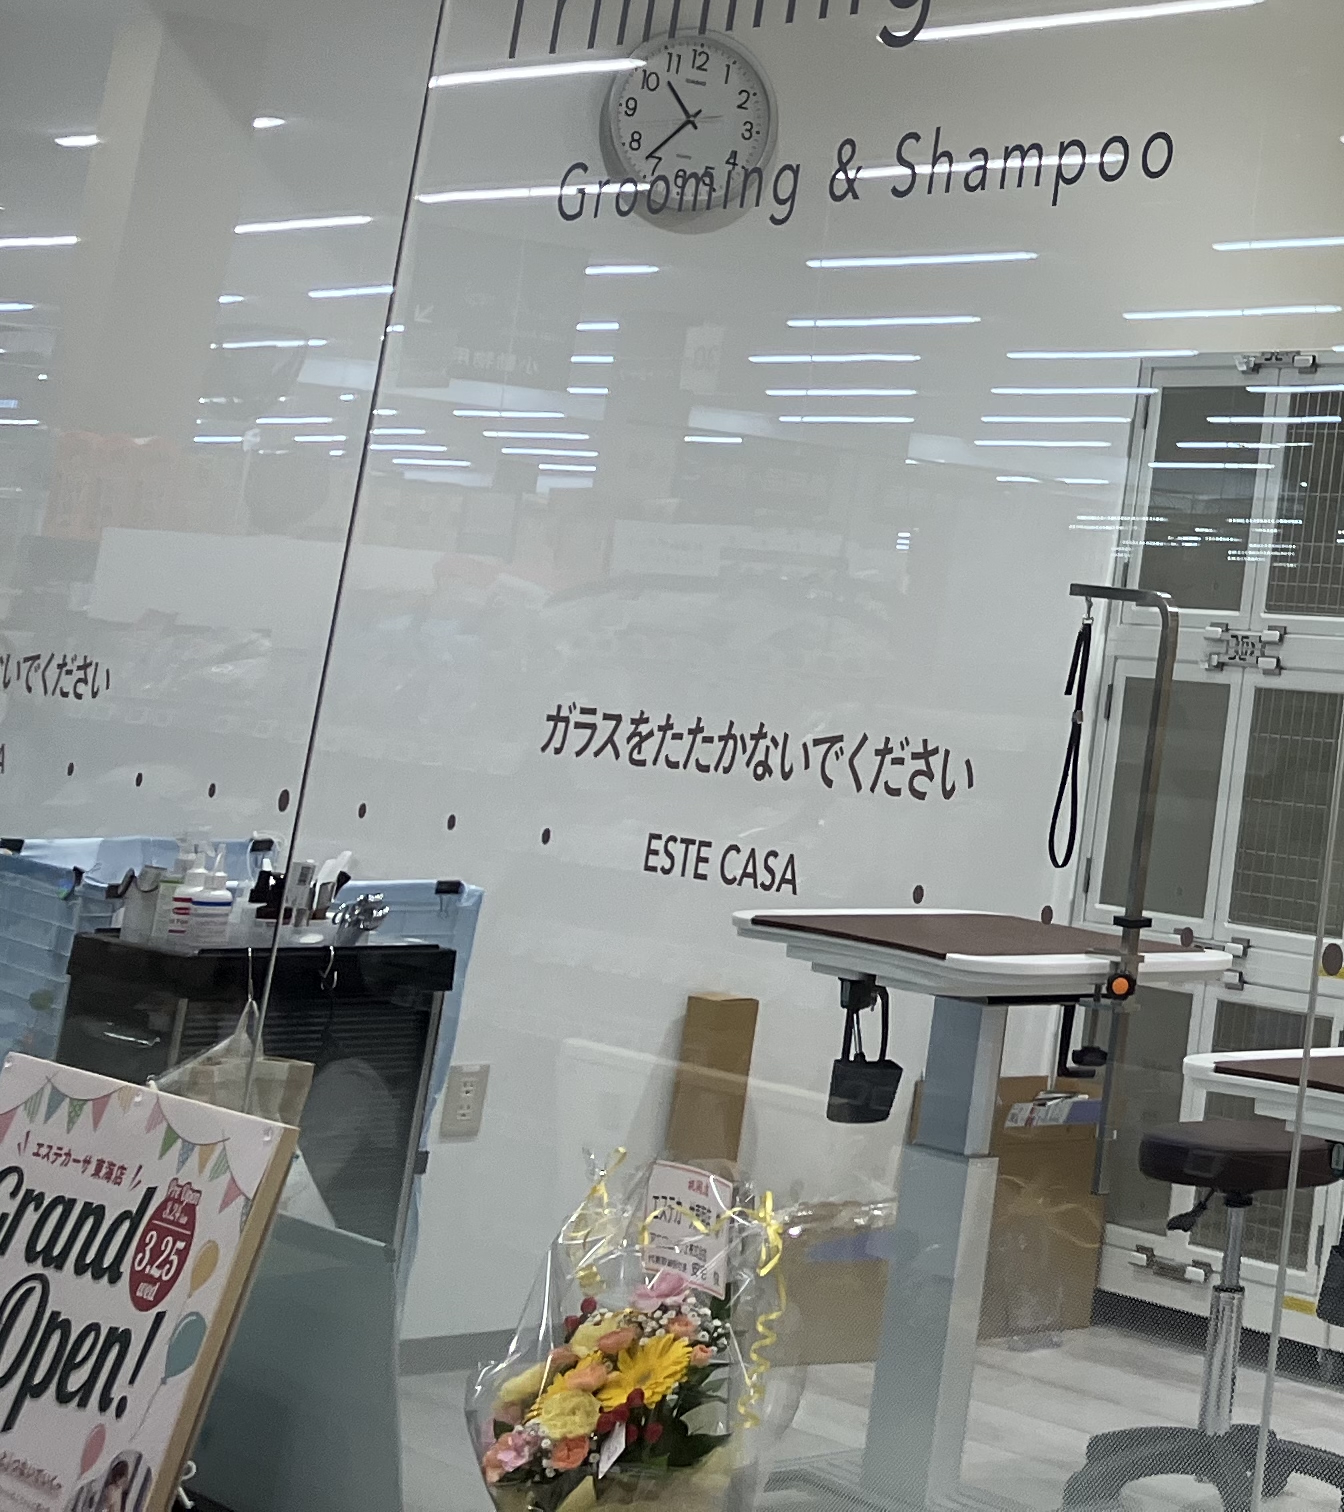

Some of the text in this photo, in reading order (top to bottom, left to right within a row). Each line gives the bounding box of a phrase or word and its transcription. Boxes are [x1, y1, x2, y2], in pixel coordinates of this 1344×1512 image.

[667, 52, 681, 74] 11
[692, 49, 709, 72] 12
[641, 69, 660, 92] 10
[724, 63, 731, 85] 1
[624, 97, 638, 117] 9
[737, 90, 750, 110] 2
[629, 131, 642, 151] 8
[741, 121, 754, 140] 3
[557, 127, 1175, 226] Grooming & Shampoo
[650, 154, 662, 176] 7
[0, 652, 110, 700] いでください
[540, 701, 974, 801] ガラスをたたかないでください
[644, 833, 799, 896] ESTE CASA
[134, 1230, 186, 1281] 3.25
[0, 1272, 167, 1432] Open!
